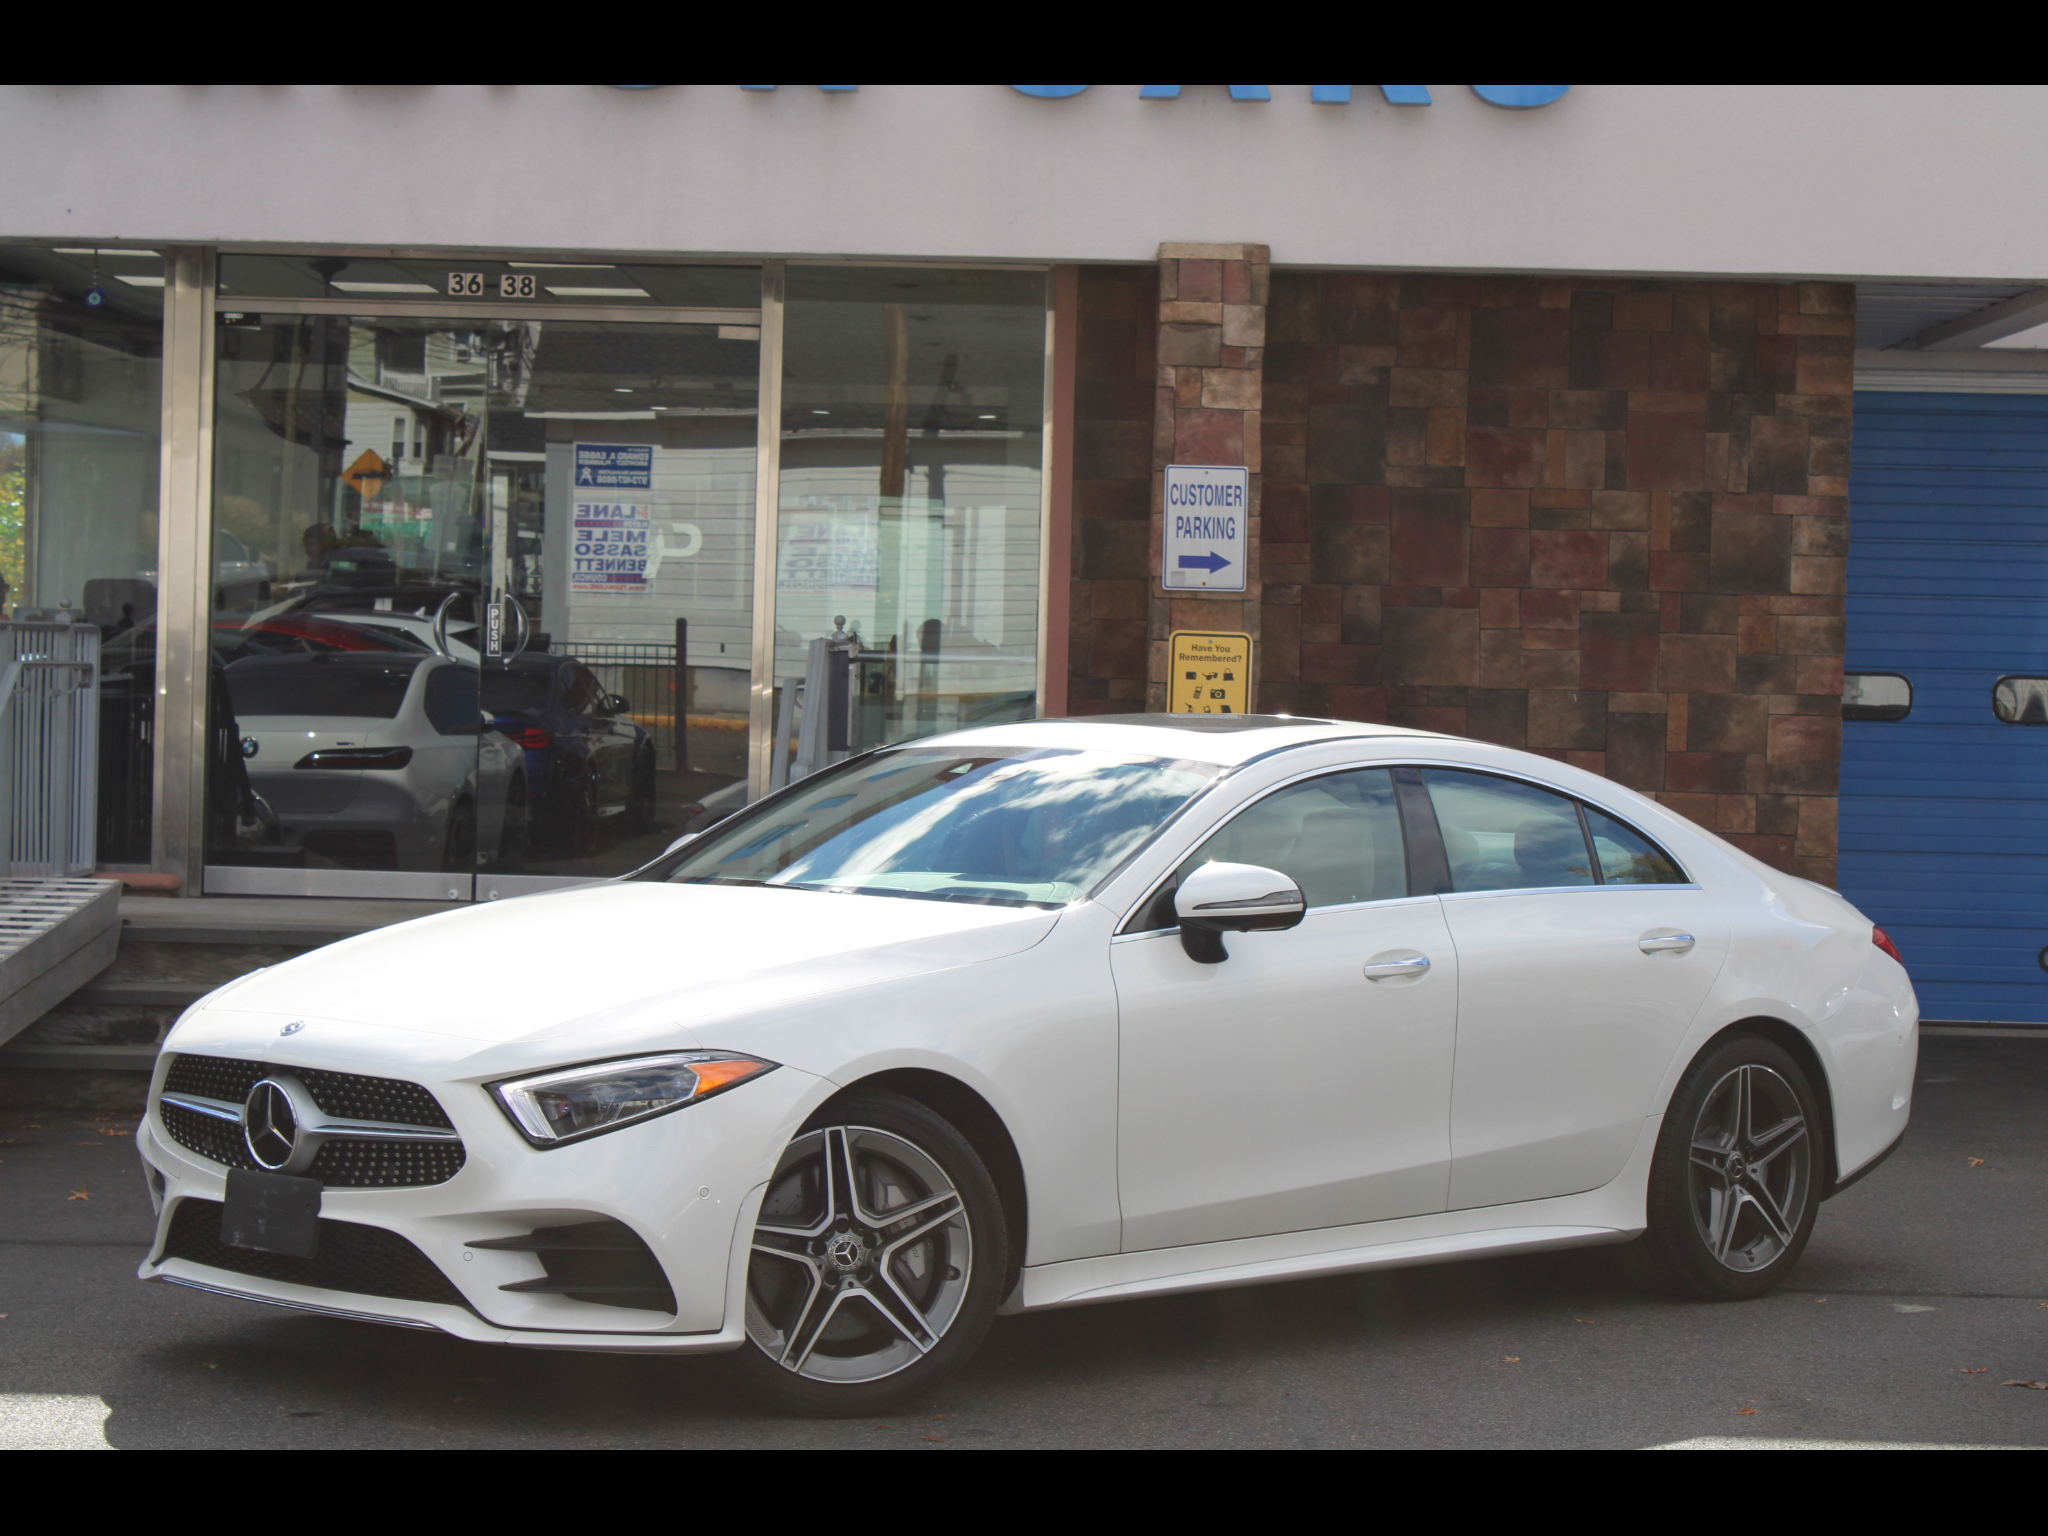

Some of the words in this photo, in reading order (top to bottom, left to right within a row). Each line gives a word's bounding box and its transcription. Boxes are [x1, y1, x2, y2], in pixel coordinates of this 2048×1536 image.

[1170, 483, 1242, 507] CUSTOMER
[1176, 516, 1236, 540] PARKING
[490, 608, 499, 651] PUSH
[1179, 653, 1242, 663] Remembered?
[1191, 644, 1213, 652] Have
[1215, 644, 1231, 652] You
